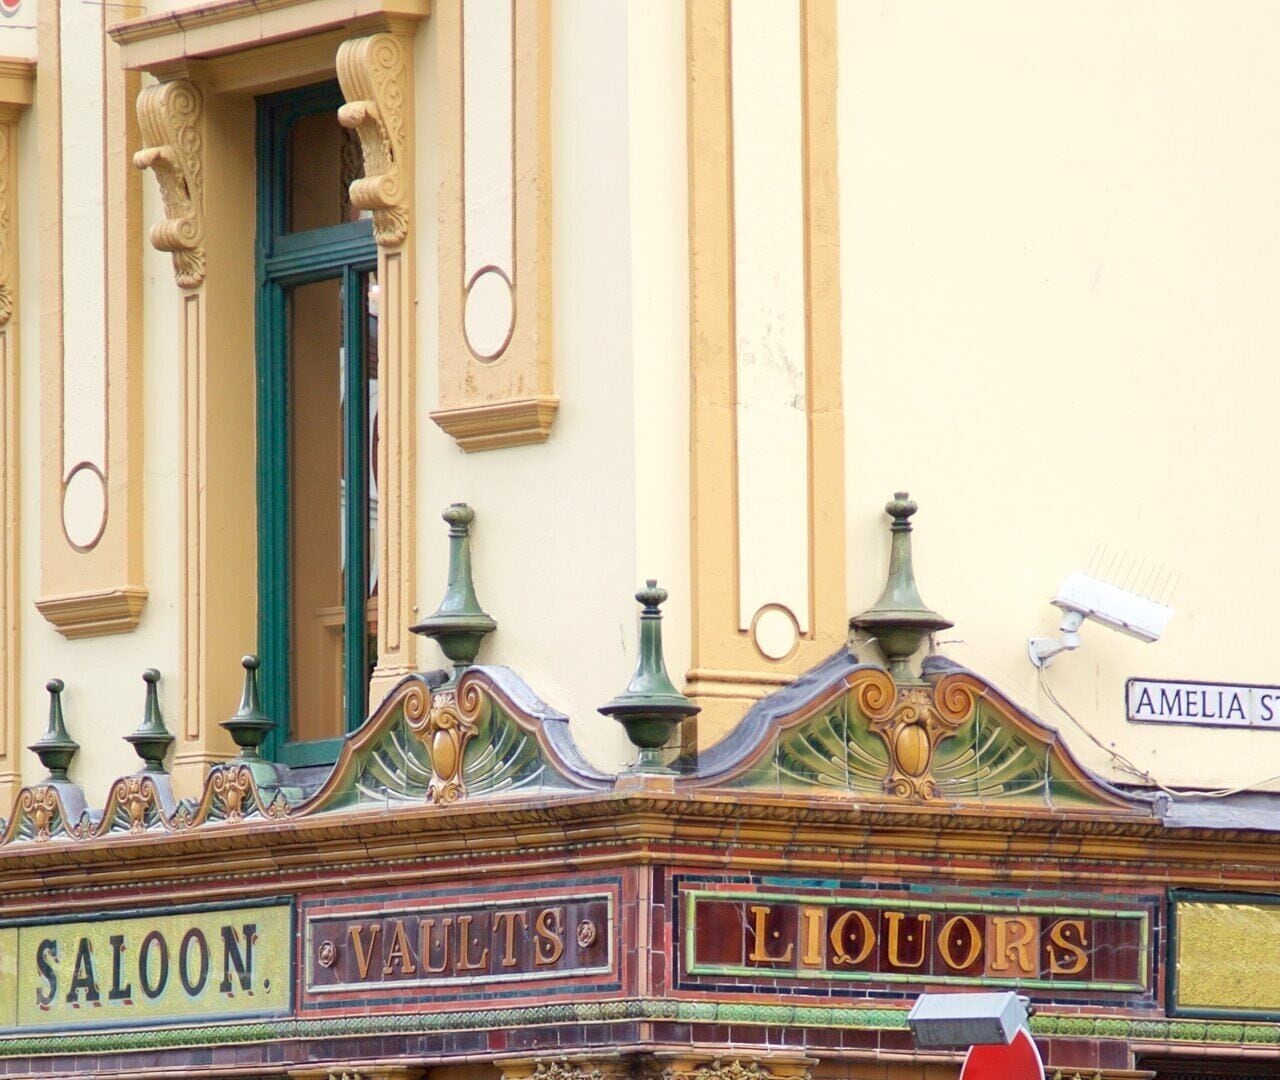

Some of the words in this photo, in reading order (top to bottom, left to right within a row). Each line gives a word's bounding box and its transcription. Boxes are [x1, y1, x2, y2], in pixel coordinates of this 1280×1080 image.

[1135, 687, 1246, 720] AMELIA
[36, 922, 272, 1009] SALOON.
[347, 908, 564, 979] VAULTS
[749, 906, 1089, 975] LIQUORS
